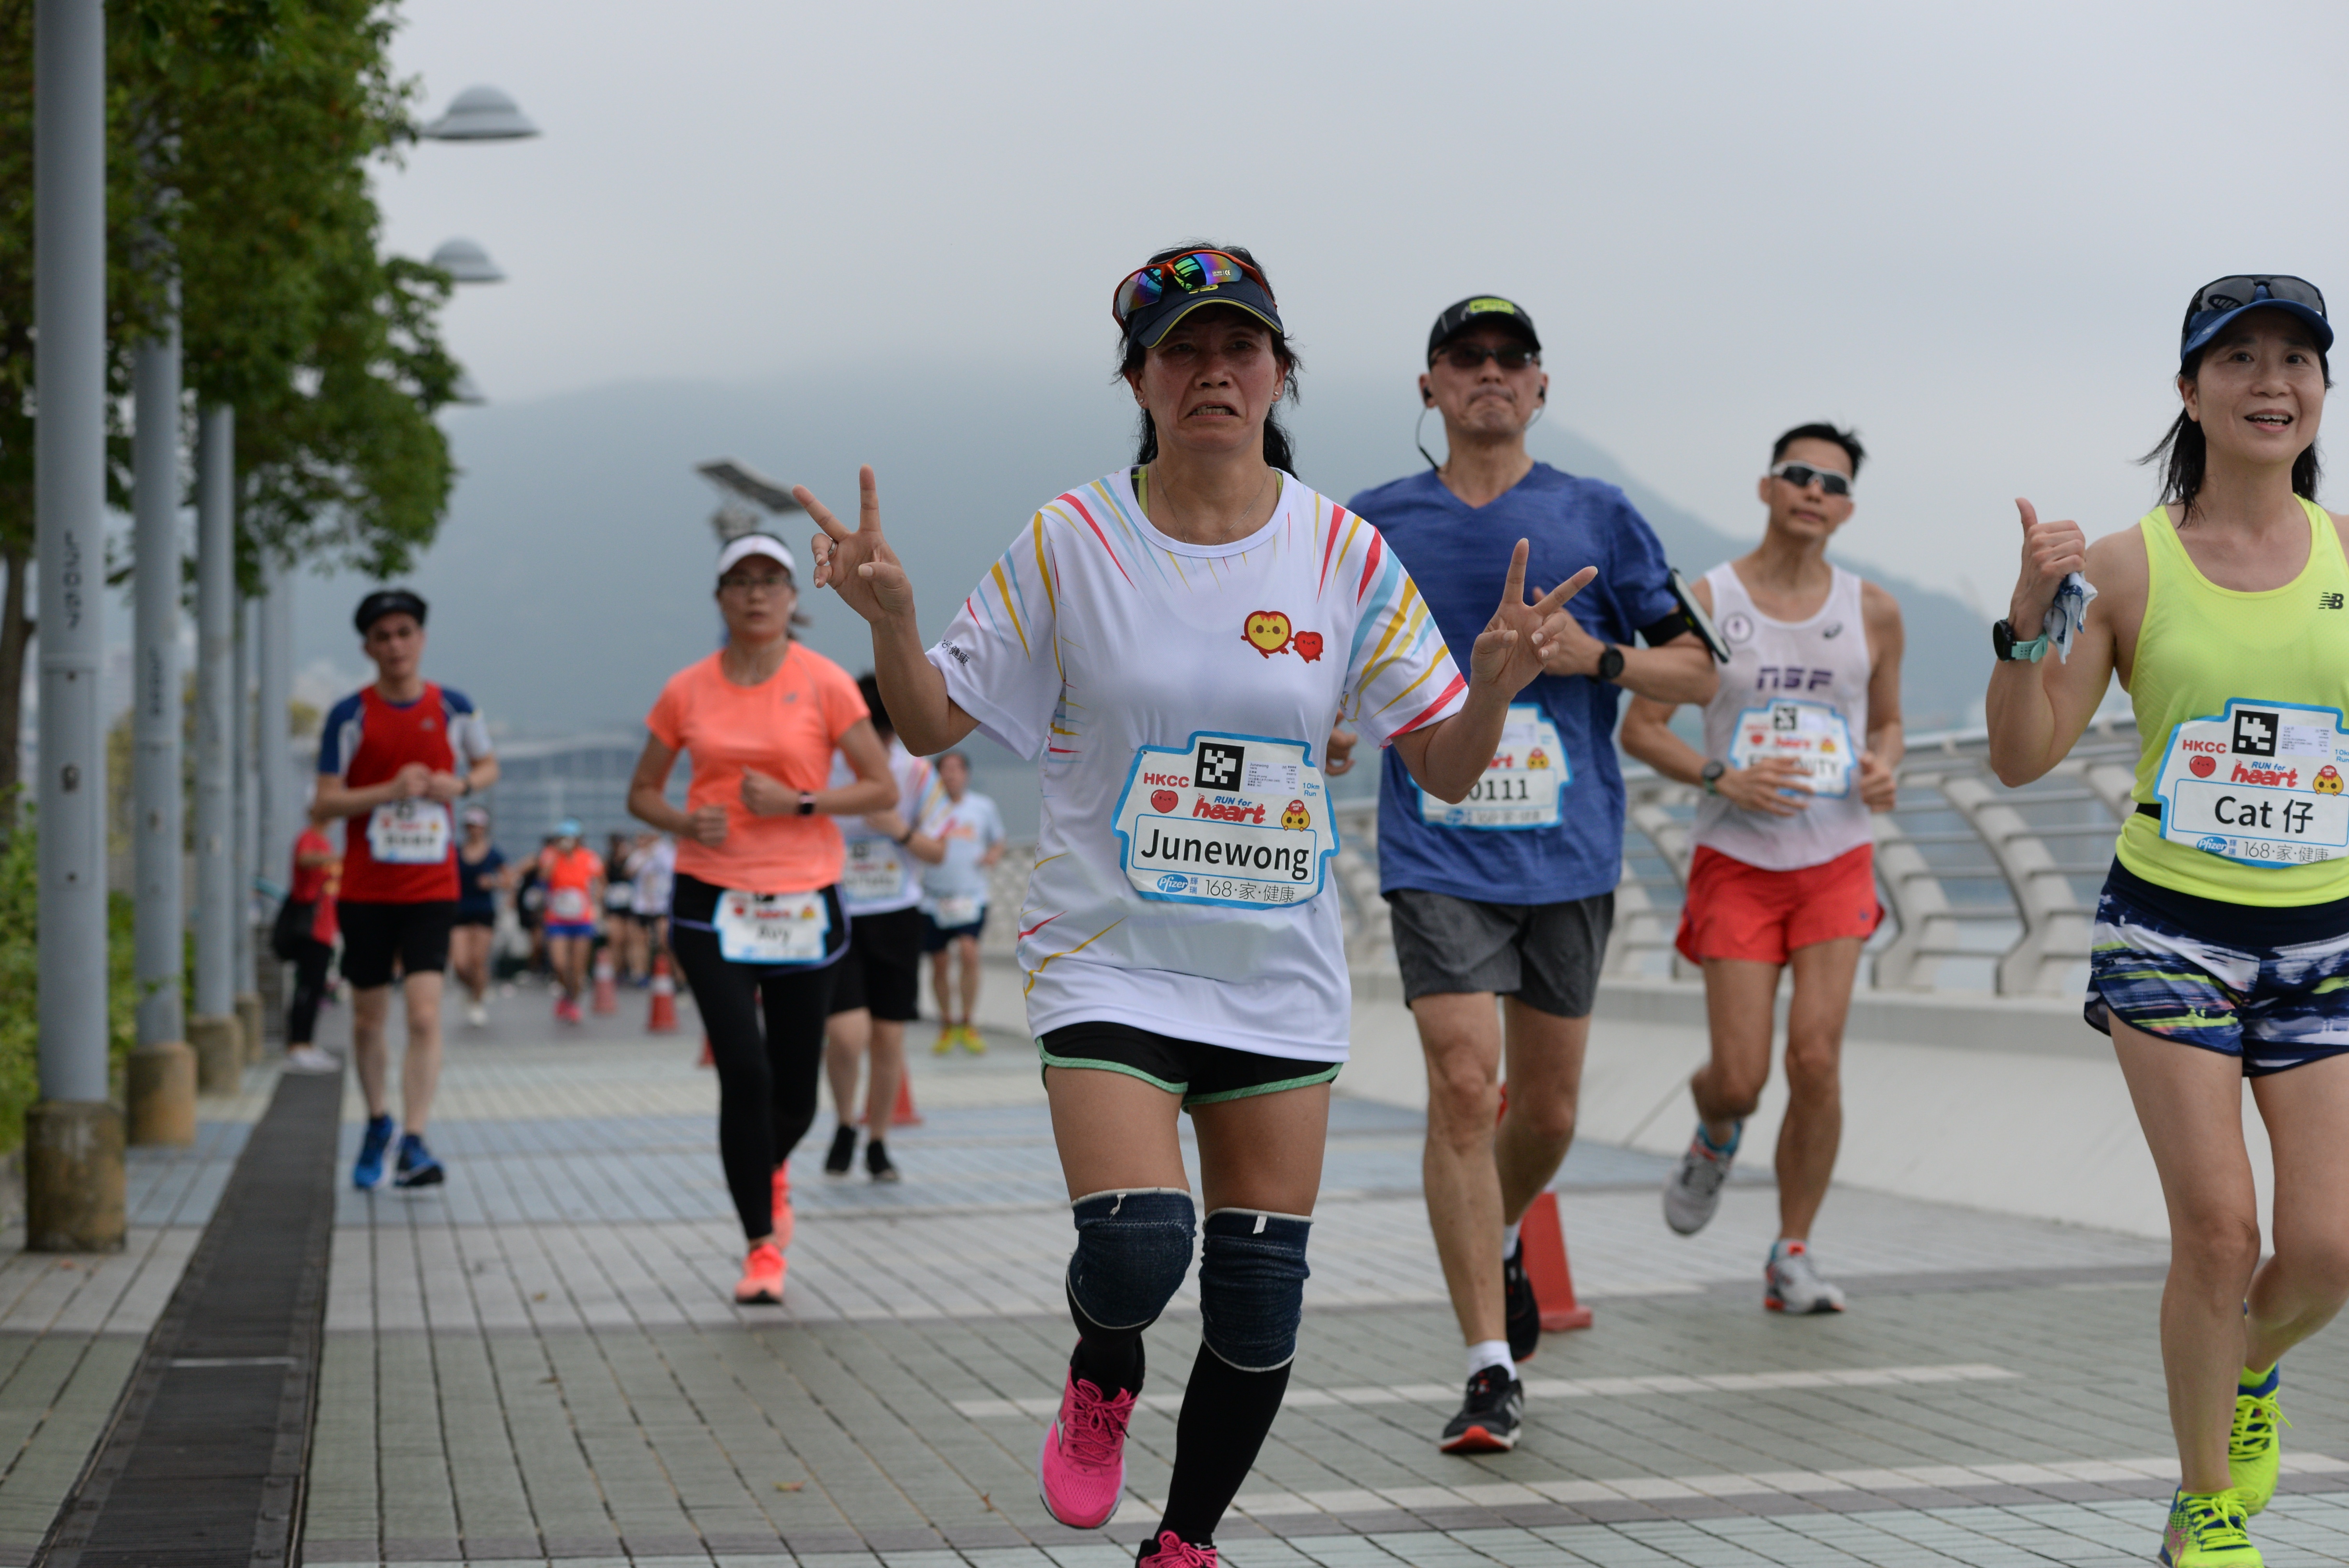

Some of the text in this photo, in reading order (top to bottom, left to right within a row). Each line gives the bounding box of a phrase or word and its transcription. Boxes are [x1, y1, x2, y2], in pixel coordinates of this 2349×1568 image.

[2182, 739, 2227, 754] HKCC
[2251, 761, 2272, 770] RUN
[1144, 772, 1189, 788] HKCC
[2231, 761, 2298, 788] heart
[1214, 795, 1252, 807] RUN for
[1192, 795, 1266, 824] heart
[2215, 796, 2314, 834] Cat 仔
[2198, 838, 2227, 851] Pfizer
[1141, 829, 1309, 881] Junewong
[1159, 876, 1188, 893] Pfizer
